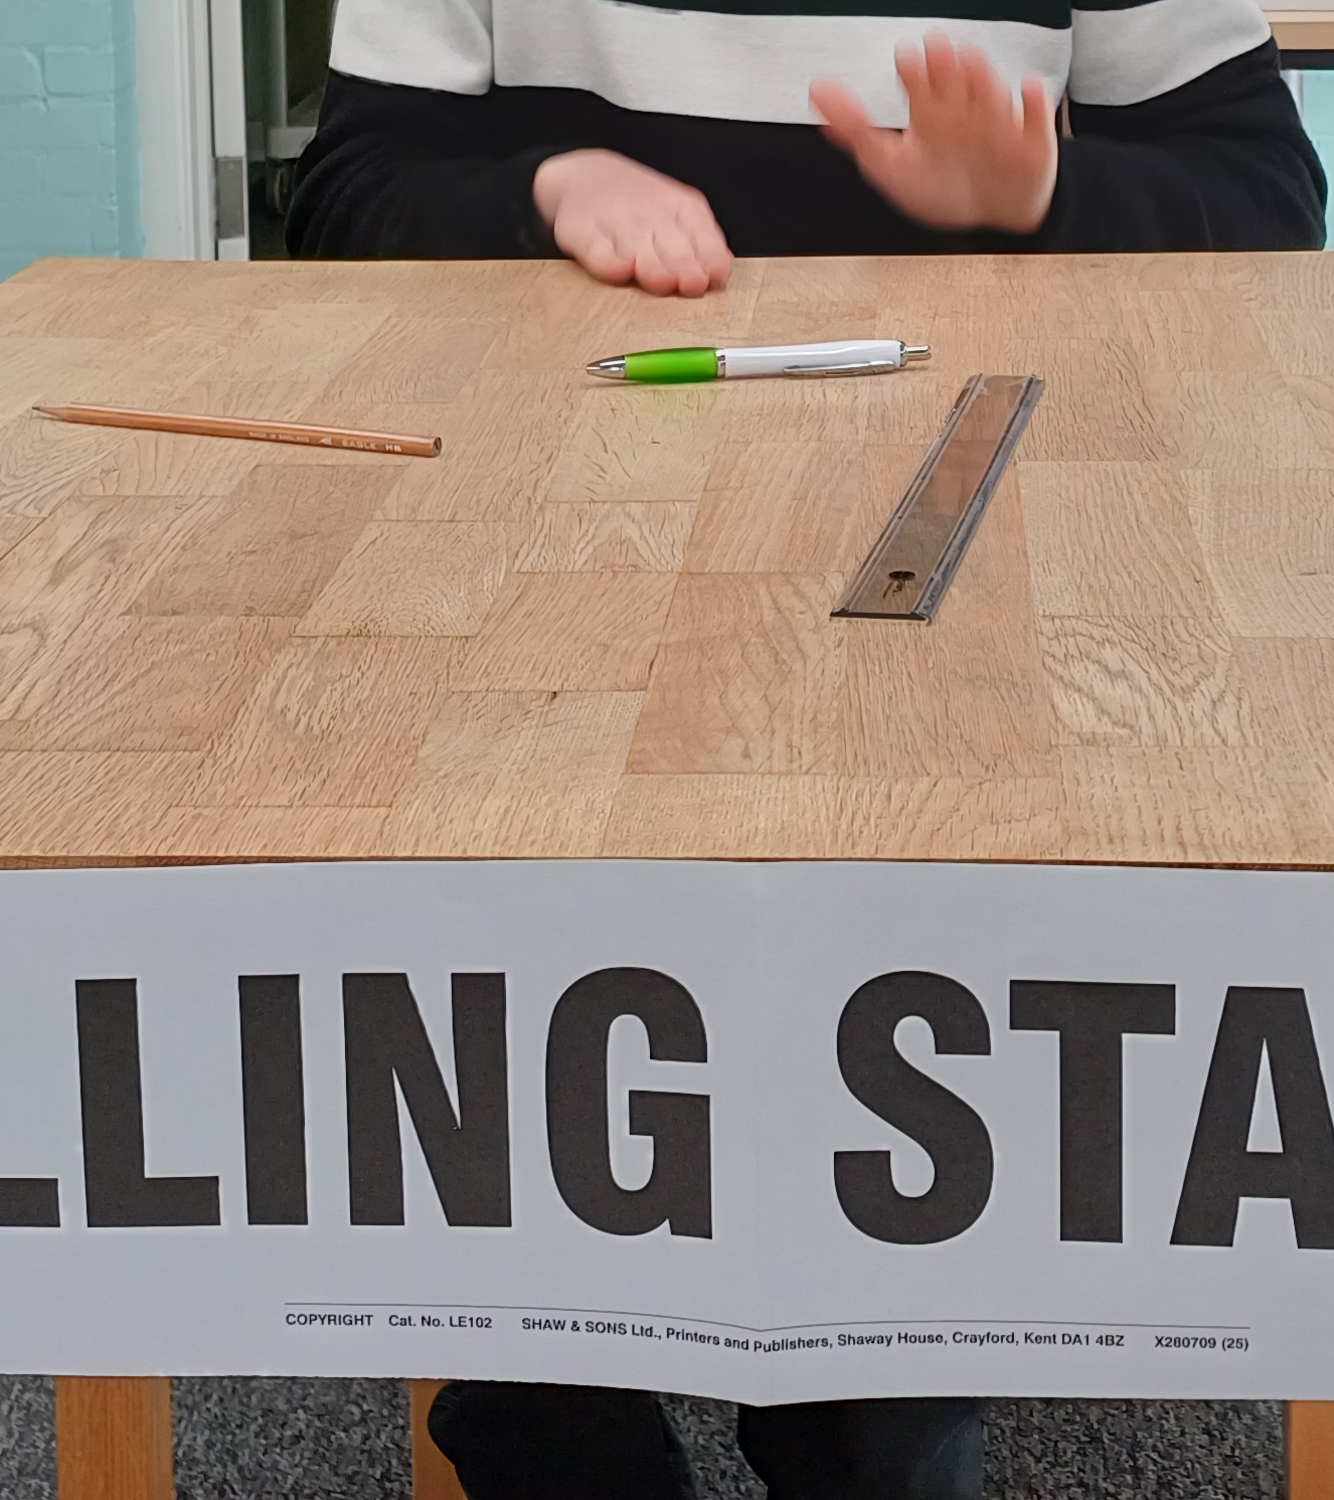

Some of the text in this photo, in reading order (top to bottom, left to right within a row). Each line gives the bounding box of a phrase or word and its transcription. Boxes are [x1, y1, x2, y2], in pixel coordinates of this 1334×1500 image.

[285, 1314, 374, 1327] COPYRIGHT
[388, 1314, 417, 1327] Cat.
[421, 1315, 445, 1328] No.
[449, 1316, 492, 1329] LE102
[522, 1318, 566, 1332] SHAW
[571, 1320, 581, 1333] &
[585, 1321, 628, 1335] SONS
[632, 1324, 661, 1340] Ltd.,
[667, 1328, 720, 1346] Printers
[724, 1337, 749, 1351] and
[754, 1334, 833, 1353] Publishers,
[838, 1333, 893, 1348] Shaway
[898, 1332, 948, 1346] House,
[952, 1331, 1019, 1347] Crayford,
[1024, 1332, 1057, 1345] Kent
[1062, 1334, 1090, 1346] DA1
[1095, 1335, 1125, 1347] 4BZ
[1221, 1336, 1249, 1352] (25)
